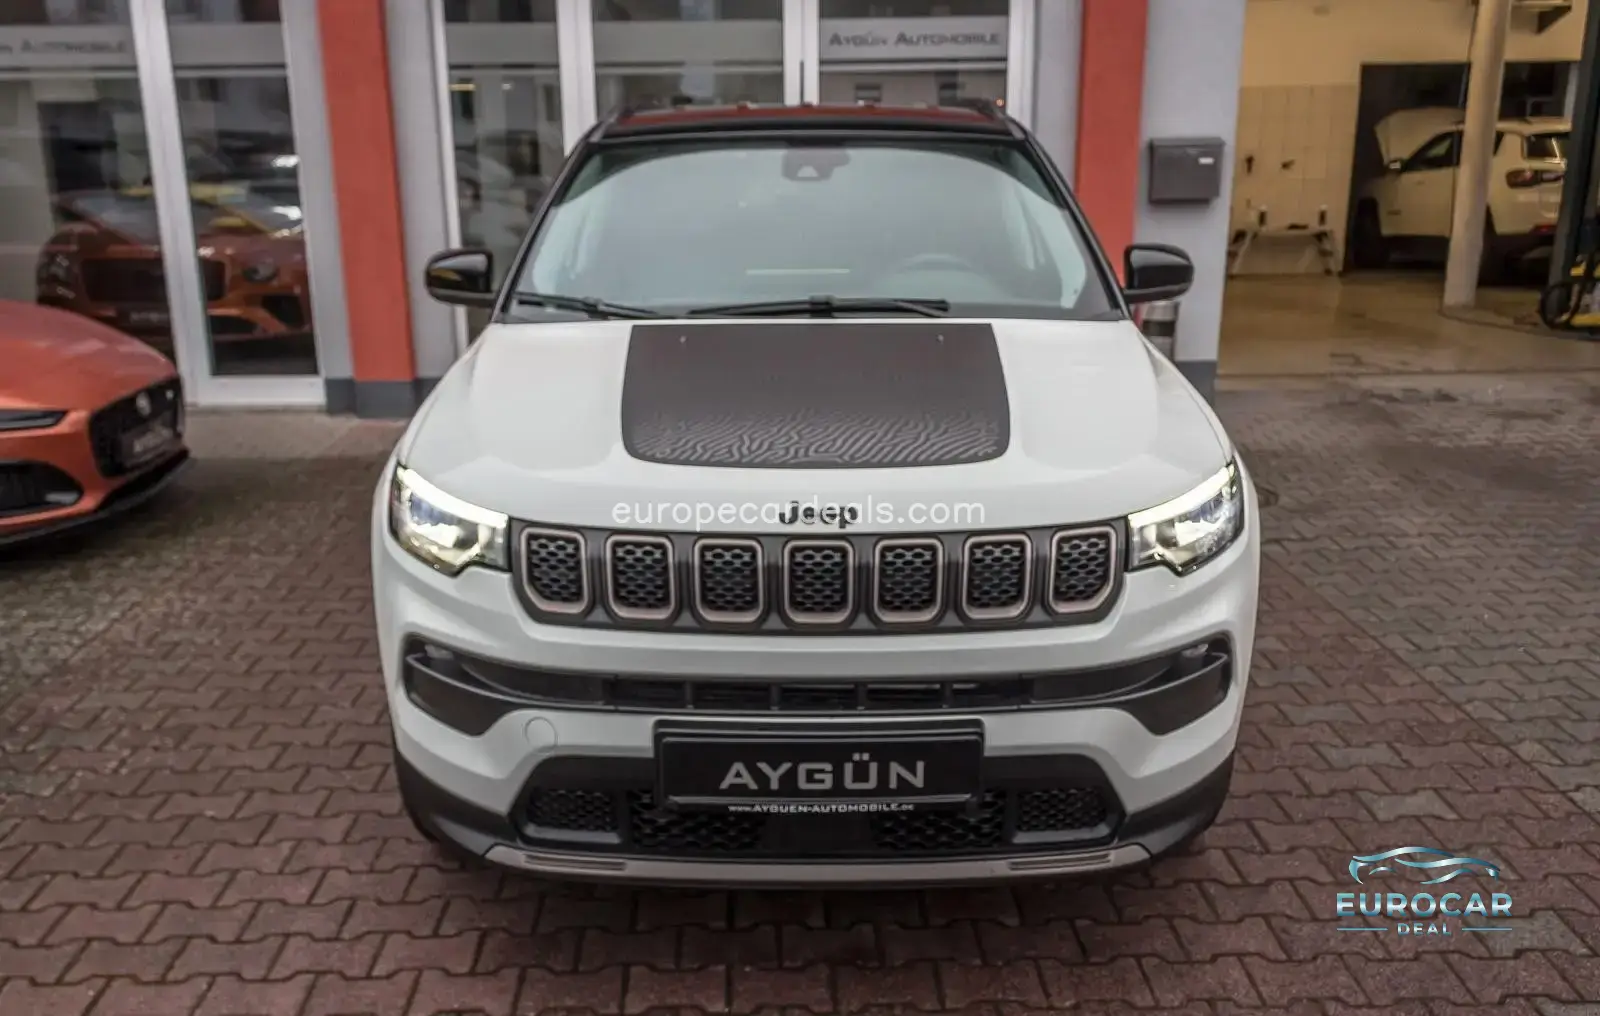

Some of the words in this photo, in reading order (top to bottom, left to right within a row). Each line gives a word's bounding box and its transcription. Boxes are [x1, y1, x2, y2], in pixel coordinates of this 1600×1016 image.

[895, 31, 1000, 47] AUTOMOBILE
[778, 501, 859, 529] Jeep
[719, 752, 925, 791] AYGÜN
